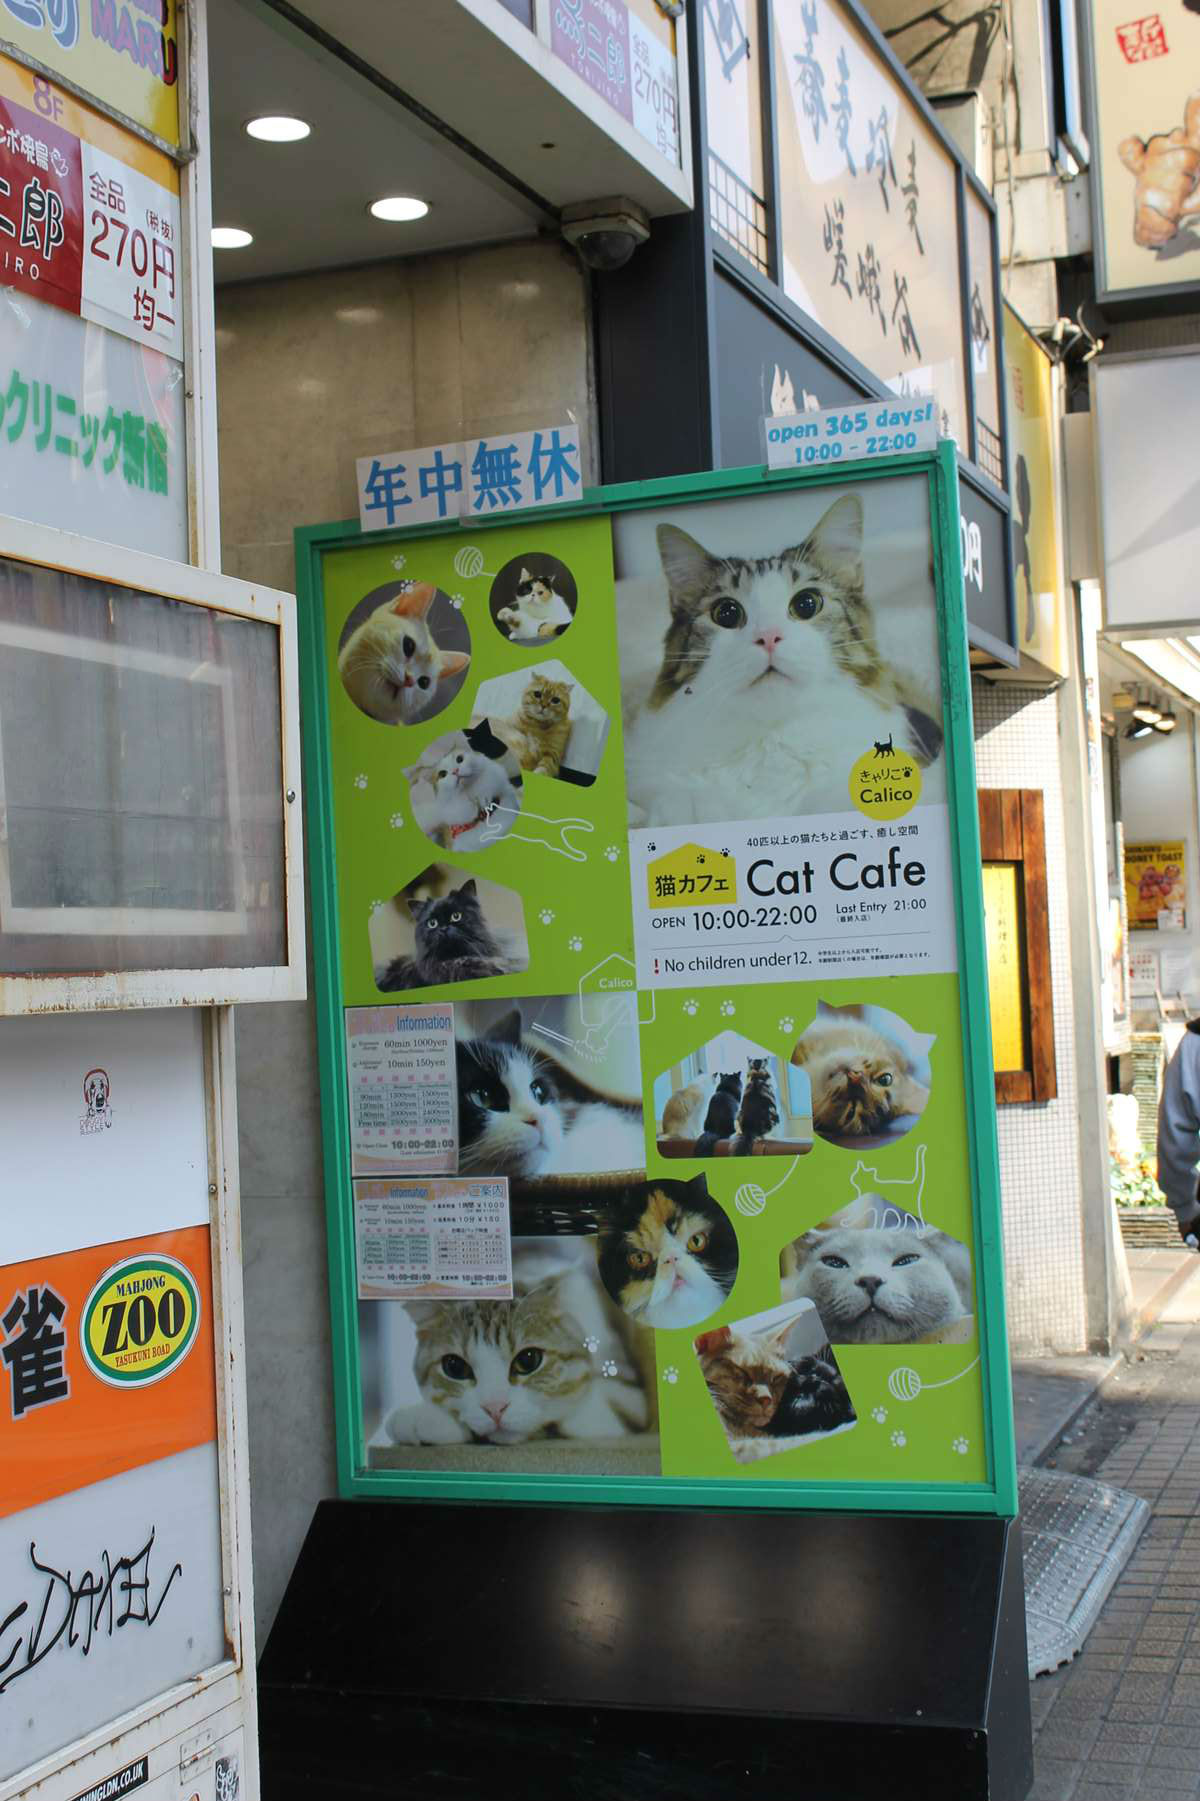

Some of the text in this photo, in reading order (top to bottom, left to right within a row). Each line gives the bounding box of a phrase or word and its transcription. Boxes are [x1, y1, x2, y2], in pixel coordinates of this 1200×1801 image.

[89, 171, 126, 214] 全品
[90, 209, 175, 300] 270円
[133, 286, 176, 332] 均一
[0, 369, 169, 497] クリニック新宿
[768, 422, 818, 444] open
[826, 411, 868, 437] 365
[876, 402, 933, 428] days!
[795, 442, 843, 464] 10:00
[866, 431, 917, 454] 22:00
[364, 430, 581, 526] 年中無休
[860, 768, 901, 783] きゃりこ
[860, 787, 912, 803] Calico
[747, 846, 926, 896] Cat Cafe
[655, 874, 729, 897] 猫カフェ
[652, 904, 817, 931] OPEN 10:00-22:00
[836, 898, 927, 914] Last Entry 21:00
[664, 959, 685, 972] No
[688, 953, 746, 971] children
[599, 978, 633, 989] Calico
[396, 1015, 451, 1032] Information
[384, 1040, 410, 1049] 60min
[414, 1038, 448, 1048] 1000yen
[387, 1060, 413, 1069] 10min
[416, 1058, 446, 1068] 150yen
[117, 1275, 165, 1296] MAHJONG
[102, 1288, 186, 1356] ZOO
[1, 1283, 69, 1416] 雀
[115, 1347, 150, 1367] YASUKUNI
[80, 1761, 144, 1801] INGLDN.CO.UK
